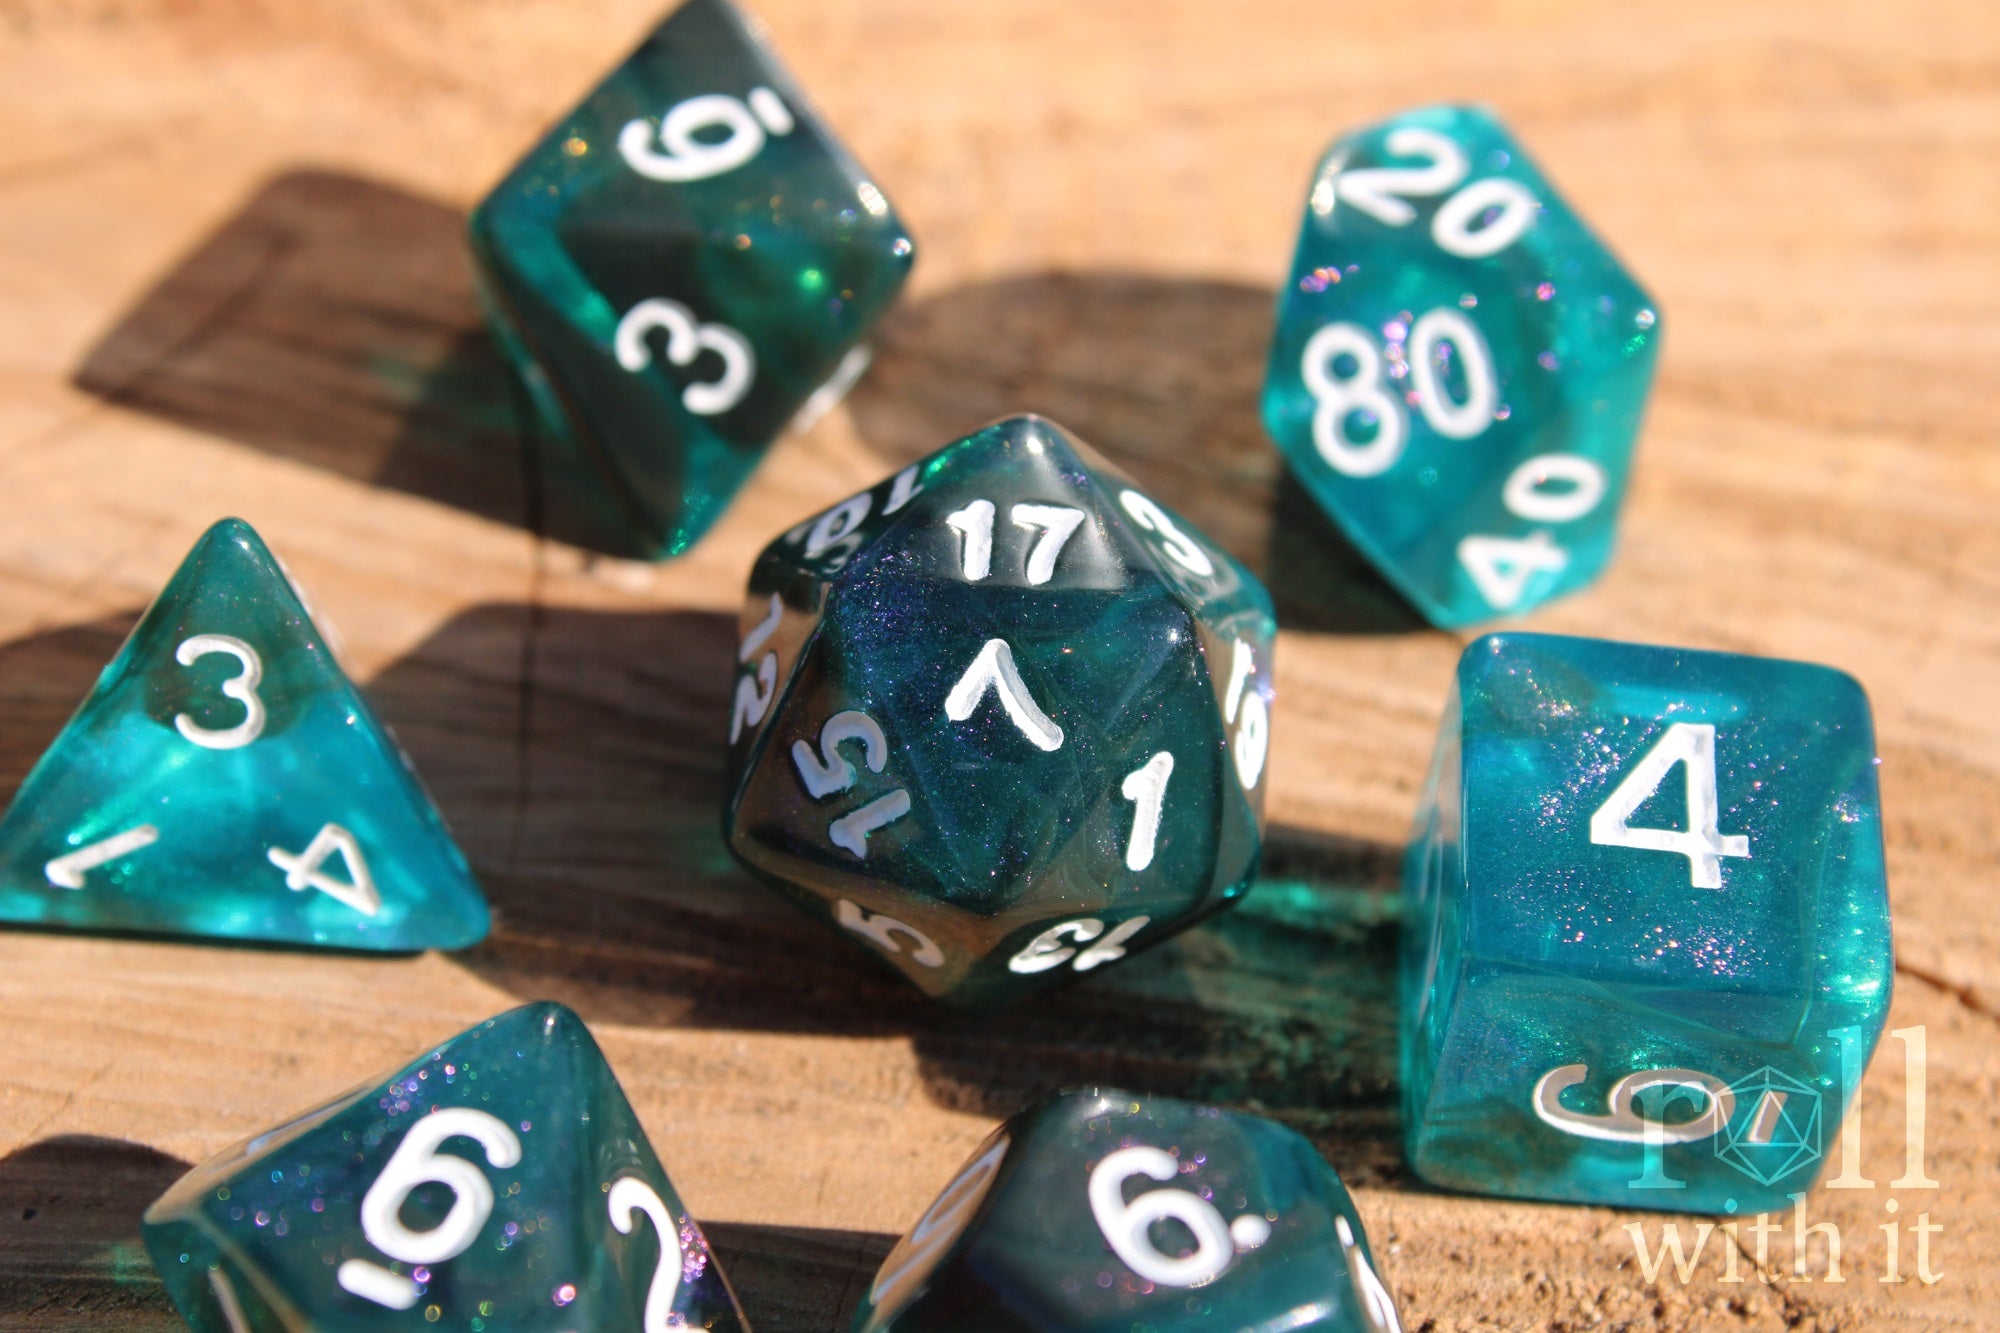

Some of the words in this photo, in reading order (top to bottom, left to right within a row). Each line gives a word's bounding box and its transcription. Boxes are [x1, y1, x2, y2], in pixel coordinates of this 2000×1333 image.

[1337, 126, 1541, 258] 20
[615, 298, 756, 416] 3
[1301, 306, 1498, 478] 80
[946, 499, 1086, 586] 17
[1118, 489, 1214, 577] 3
[1457, 452, 1607, 609] 40
[175, 634, 267, 750] 3
[945, 638, 1064, 752] 7
[791, 709, 911, 859] 15
[1121, 751, 1175, 872] 1
[1590, 723, 1750, 890] 4
[44, 823, 159, 890] 1
[267, 822, 382, 917] 4
[838, 899, 945, 968] 5
[1008, 915, 1151, 974] 13
